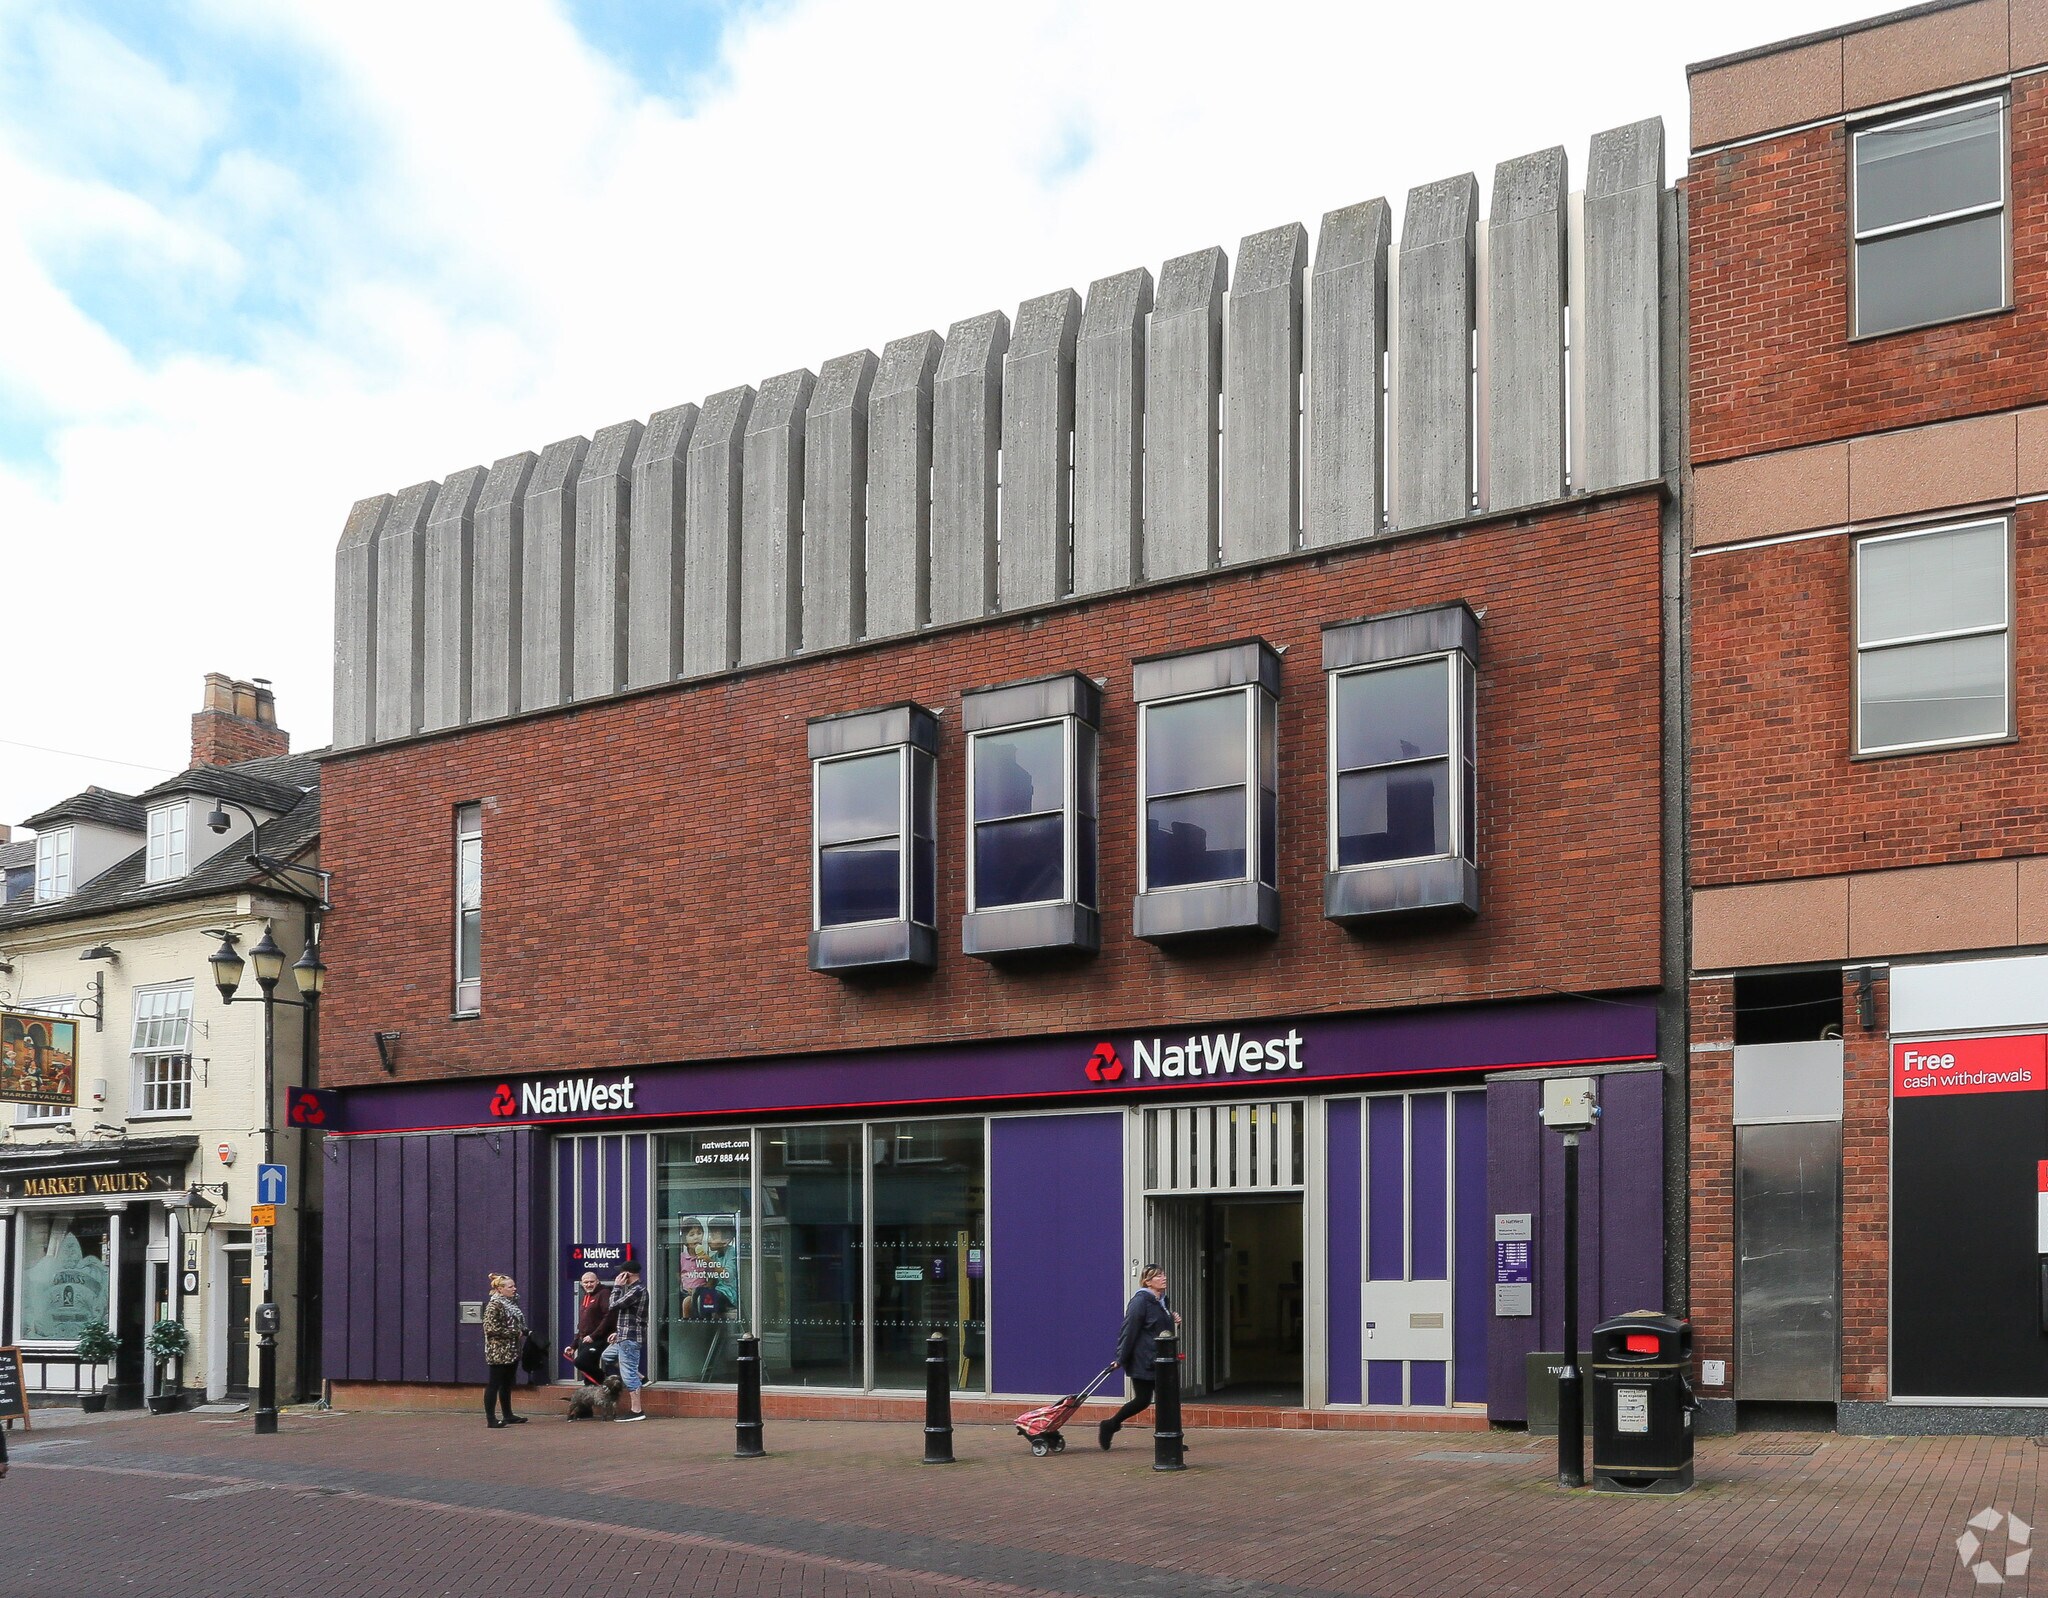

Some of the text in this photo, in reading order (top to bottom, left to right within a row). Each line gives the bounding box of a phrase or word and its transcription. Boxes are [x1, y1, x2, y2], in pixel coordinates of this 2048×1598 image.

[1133, 1028, 1303, 1079] NatWest
[1903, 1051, 1955, 1071] Free
[1903, 1067, 2032, 1089] cash withdrawals
[1, 1091, 37, 1099] MARKET
[521, 1075, 634, 1114] NatWest
[701, 1140, 750, 1149] natwest.com
[695, 1153, 750, 1164] 0345 7 888 444
[23, 1171, 150, 1197] MARKET VAULTS
[583, 1247, 620, 1259] NatWest
[695, 1259, 707, 1268] We
[688, 1269, 730, 1279] what we do
